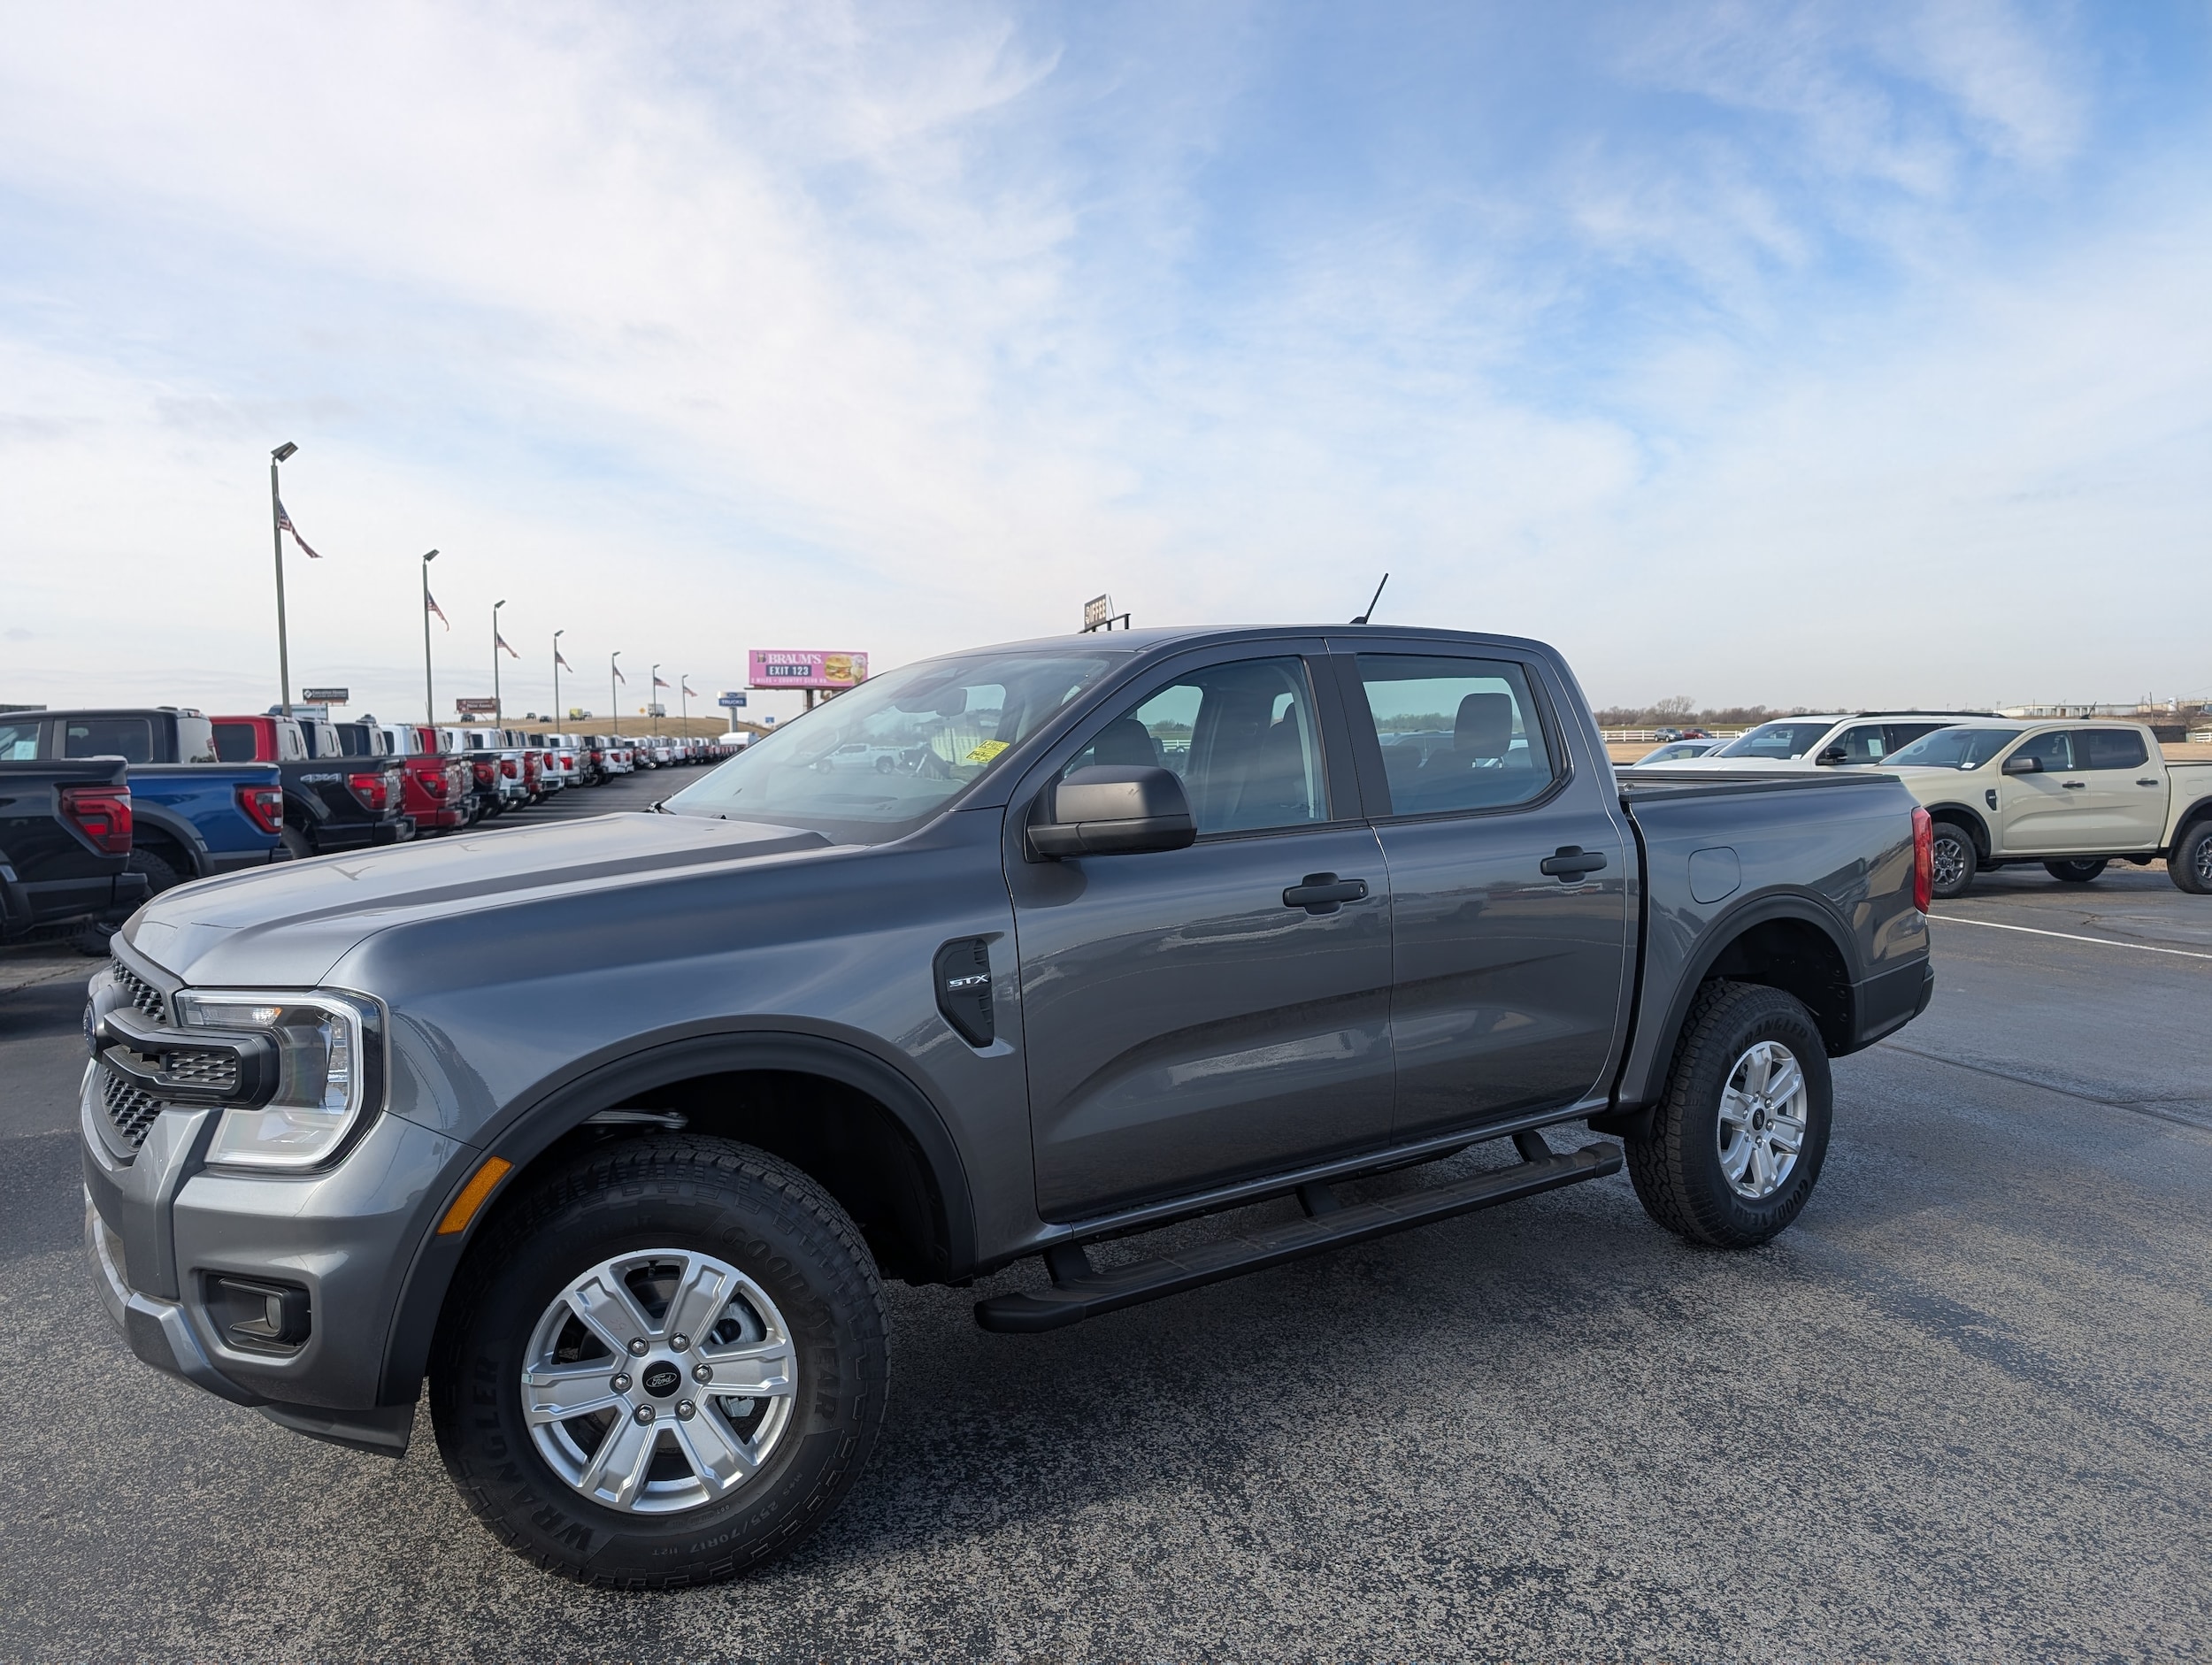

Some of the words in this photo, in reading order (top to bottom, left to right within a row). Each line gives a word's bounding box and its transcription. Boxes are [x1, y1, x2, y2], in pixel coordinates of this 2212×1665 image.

[768, 653, 822, 664] BRAUM'S
[769, 666, 788, 675] EXIT
[793, 666, 809, 676] 123
[949, 973, 989, 988] STX
[1734, 1017, 1808, 1056] WRANGLER
[1735, 1178, 1809, 1228] GOODYEAR
[721, 1226, 840, 1420] GOODYEAR
[651, 1374, 672, 1386] Ford
[473, 1356, 595, 1552] WRANGLER
[689, 1500, 780, 1554] 255/70R17
